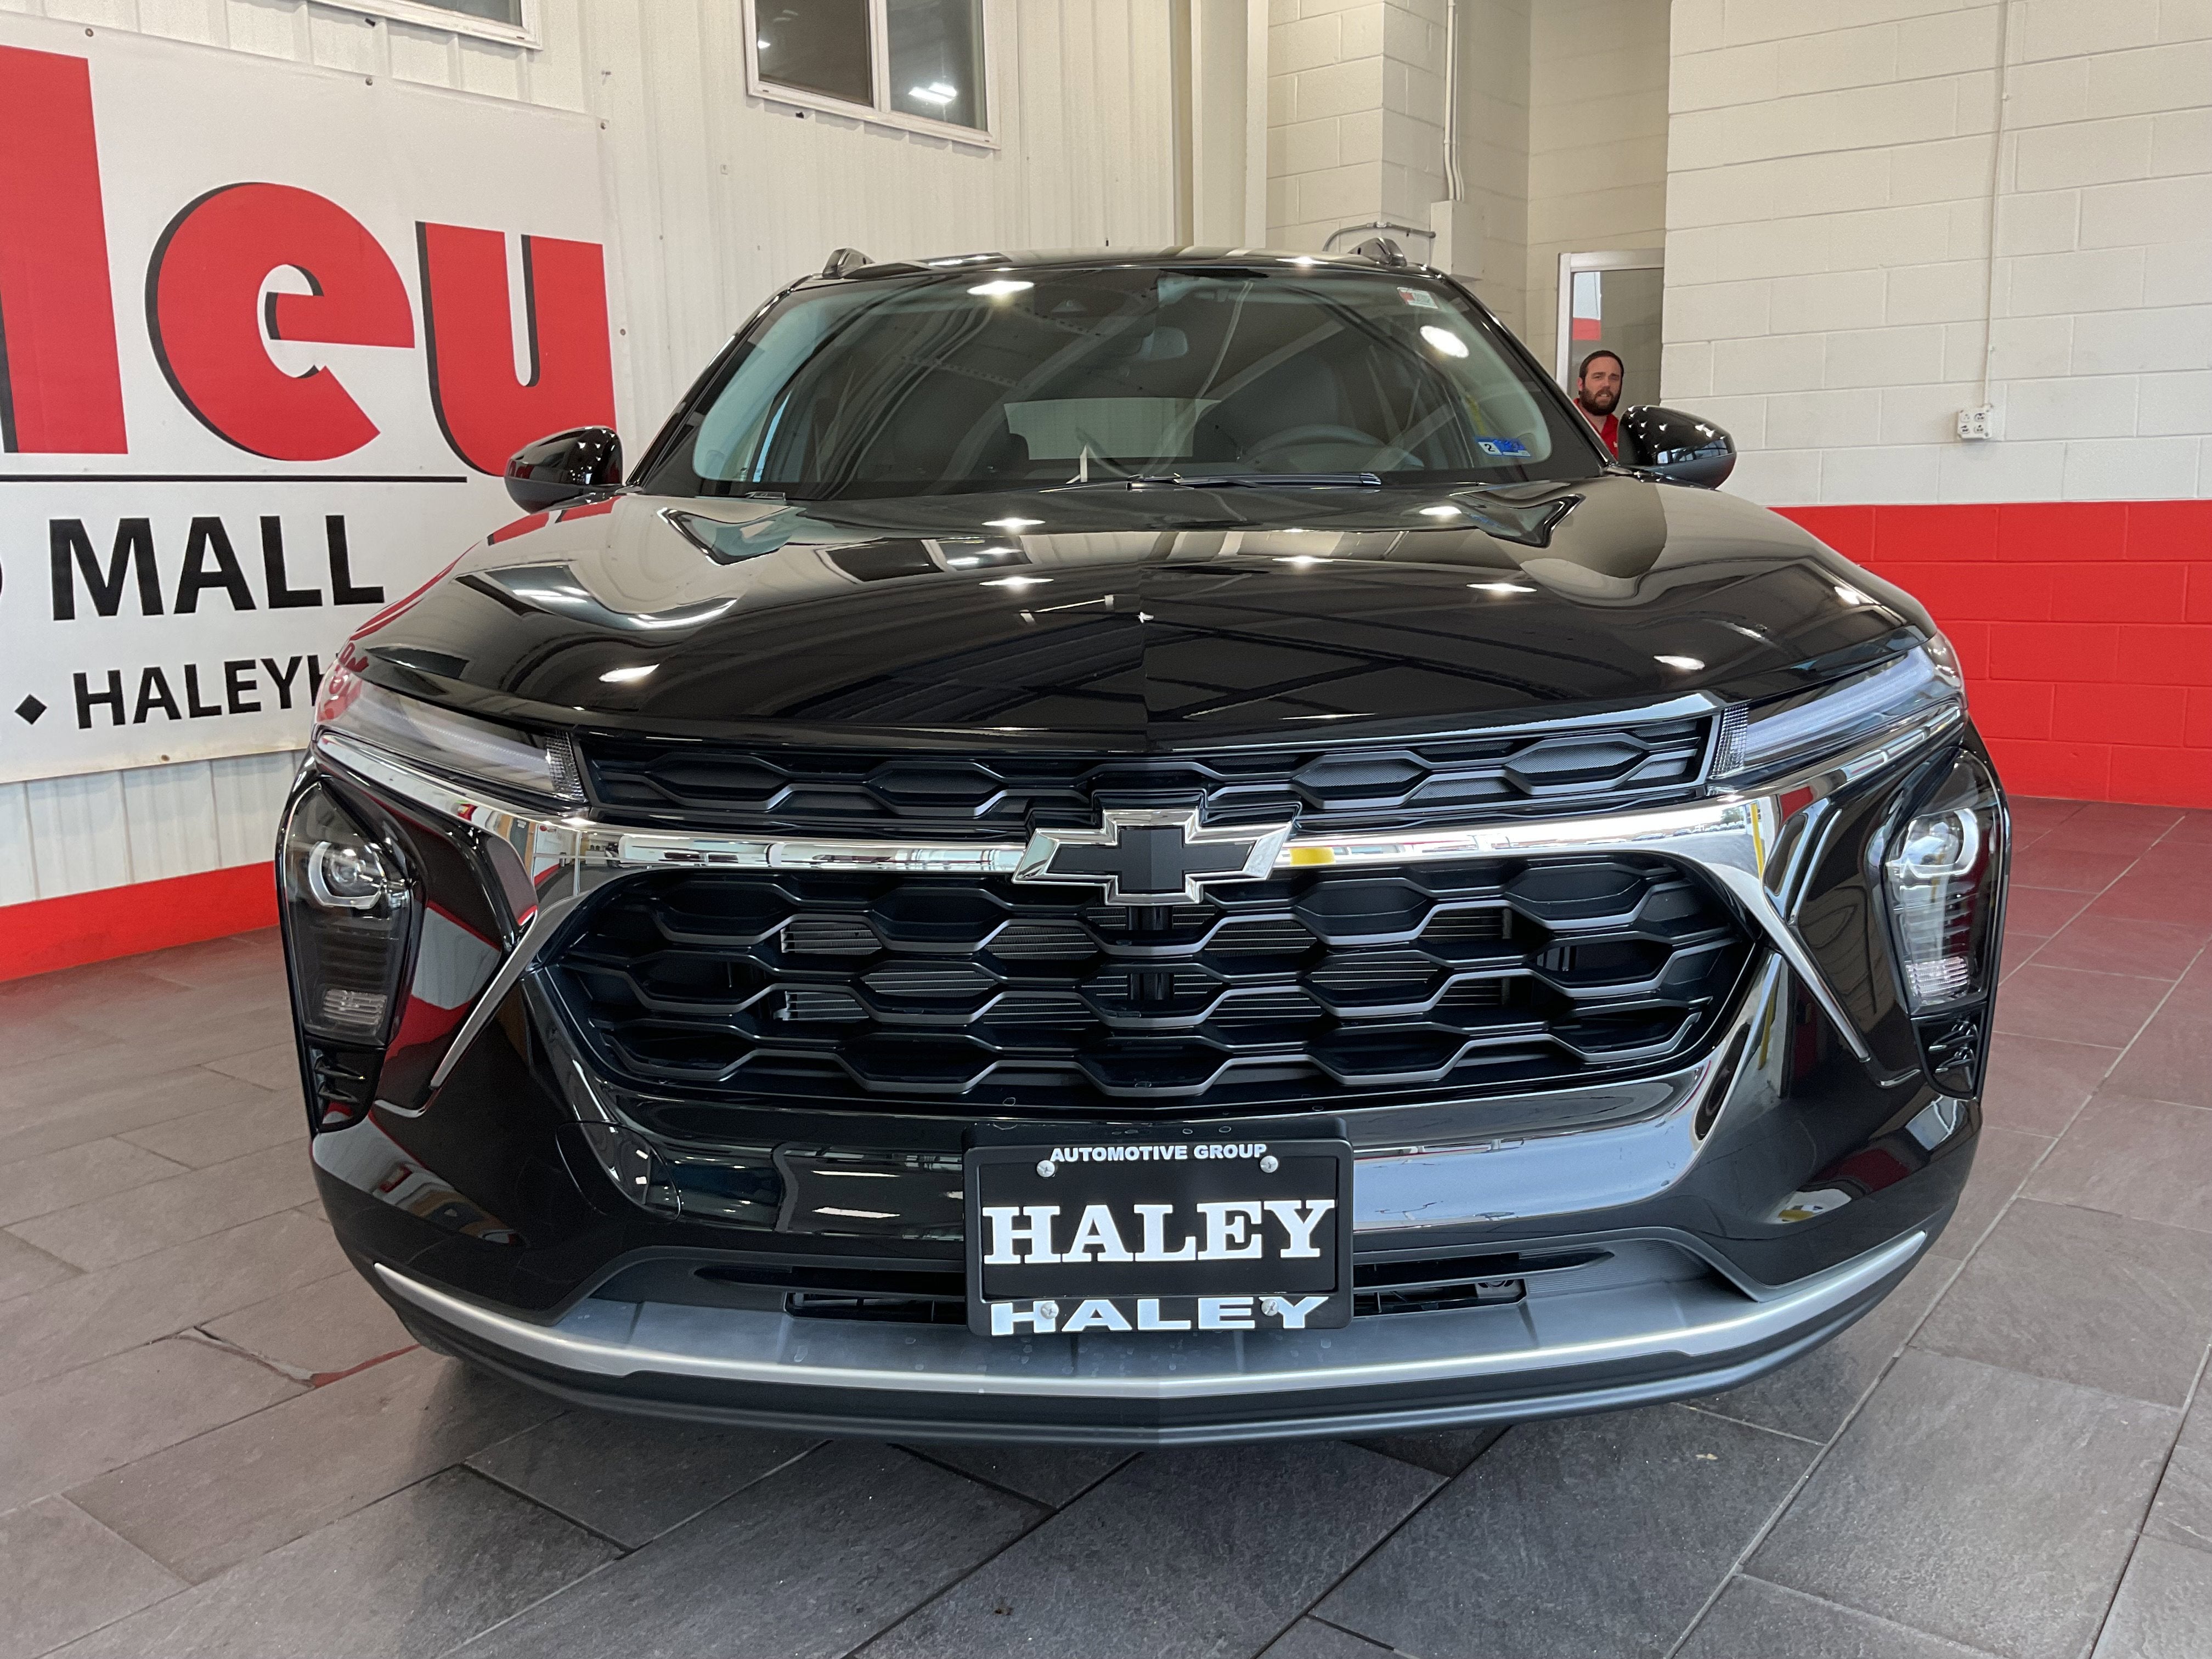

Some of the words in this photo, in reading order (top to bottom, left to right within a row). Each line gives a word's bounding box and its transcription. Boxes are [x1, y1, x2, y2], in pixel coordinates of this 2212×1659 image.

[1484, 443, 1495, 452] 2
[49, 515, 385, 620] MALL
[1050, 1146, 1187, 1162] AUTOMOTIVE
[1194, 1144, 1267, 1159] GROUP
[982, 1199, 1335, 1264] HALEY
[991, 1296, 1329, 1335] HALEY
